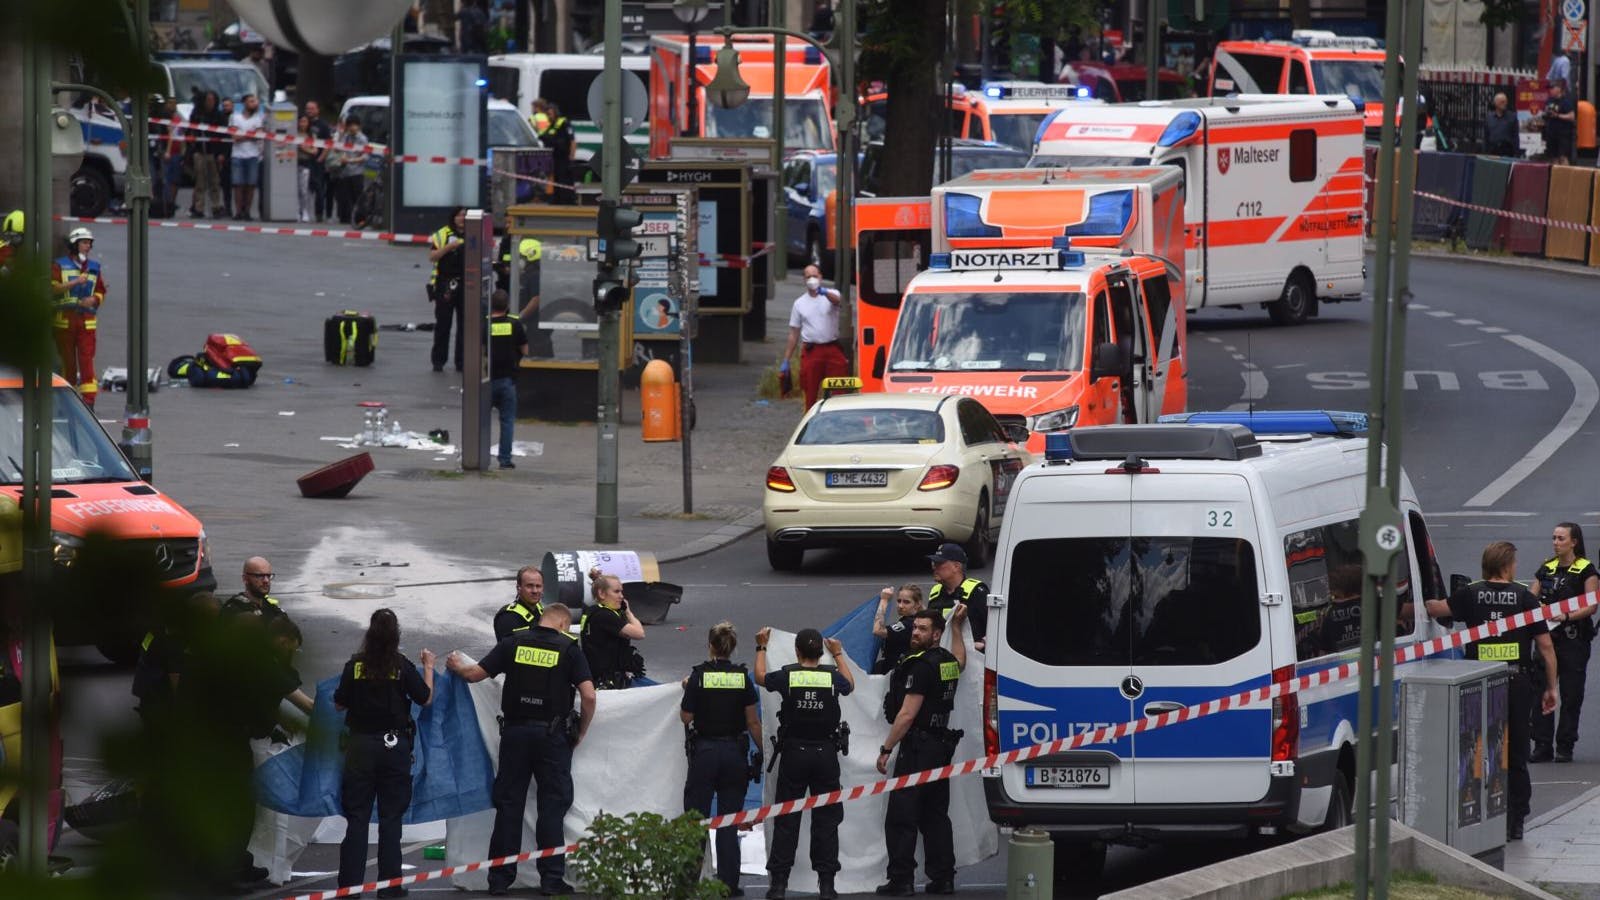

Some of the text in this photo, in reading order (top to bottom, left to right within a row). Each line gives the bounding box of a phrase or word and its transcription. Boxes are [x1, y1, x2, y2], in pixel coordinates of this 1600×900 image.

[1012, 87, 1066, 97] FEUERWEHR
[1234, 146, 1280, 165] Malteser
[679, 172, 712, 182] HYGH
[1245, 200, 1262, 216] 112
[955, 253, 1054, 267] NOTARZT
[828, 379, 855, 389] TAXI
[1306, 370, 1549, 390] BUS
[832, 473, 839, 484] B
[861, 471, 886, 484] 4432
[1207, 510, 1233, 527] 32
[1478, 591, 1517, 605] POLIZEI
[517, 648, 557, 665] POLIZEI
[1480, 645, 1517, 659] POLIZEI
[704, 673, 744, 687] POLIZEI
[520, 696, 544, 705] POLIZEI
[805, 691, 817, 700] BE
[797, 700, 824, 709] 32326
[1041, 769, 1101, 782] B 31876
